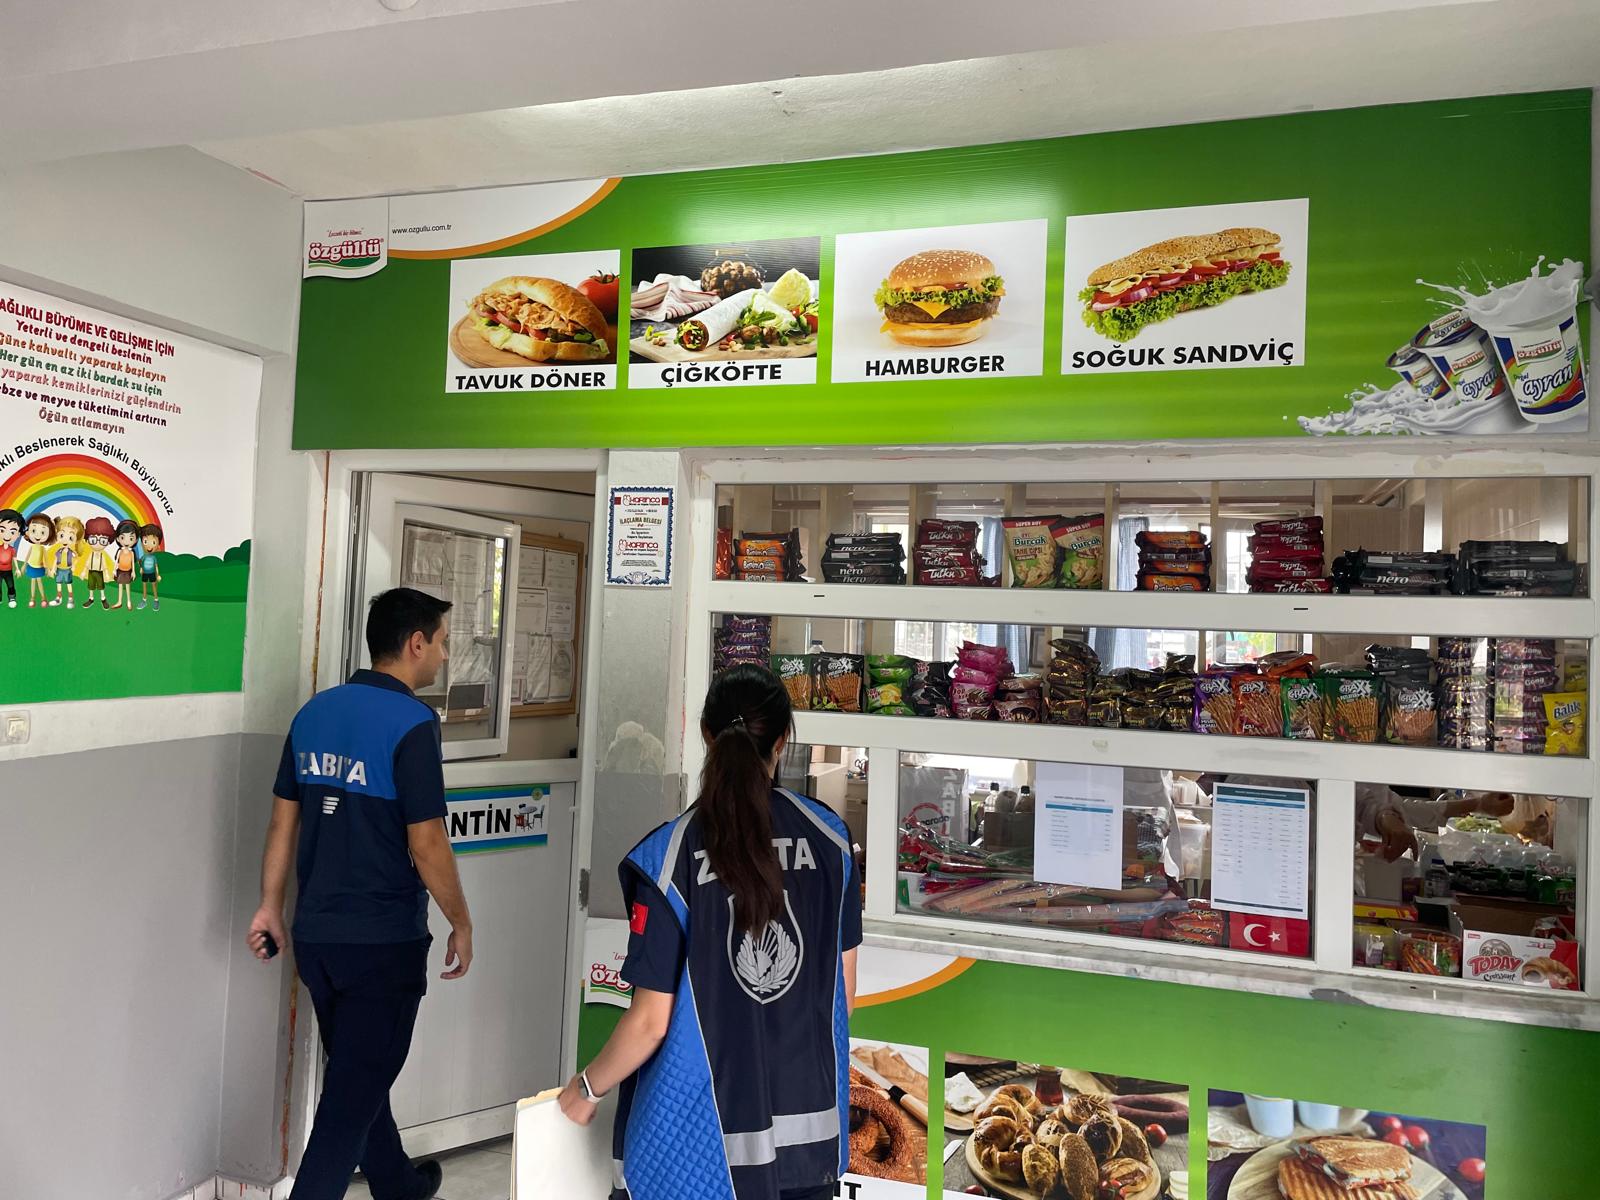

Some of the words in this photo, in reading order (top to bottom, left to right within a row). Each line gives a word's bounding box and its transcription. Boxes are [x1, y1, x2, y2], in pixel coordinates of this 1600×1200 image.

[391, 224, 452, 235] www.ozgullu.com.tr
[309, 238, 381, 263] özgüllü
[16, 320, 53, 339] Yeterli
[55, 332, 68, 342] ve
[70, 334, 109, 353] dengeli
[111, 344, 152, 364] beslenin
[45, 311, 93, 335] BÜYÜME
[94, 324, 108, 338] VE
[109, 329, 153, 351] GELİŞME
[155, 339, 175, 357] İÇİN
[29, 339, 77, 361] kahvaltı
[79, 354, 123, 371] yaparak
[125, 363, 166, 383] başlayın
[865, 355, 1005, 377] HAMBURGER
[1071, 344, 1165, 369] SOĞUK
[1173, 338, 1294, 366] SANDVİÇ
[0, 349, 19, 362] Her
[20, 356, 42, 368] gün
[45, 362, 58, 372] en
[60, 366, 74, 376] az
[77, 367, 91, 379] iki
[93, 371, 129, 388] bardak
[131, 382, 142, 391] su
[144, 383, 162, 396] için
[455, 373, 524, 391] TAVUK
[530, 369, 607, 388] DÖNER
[660, 362, 782, 388] ÇİĞKÖFTE
[1463, 367, 1498, 399] ayran
[1523, 365, 1573, 401] ayran
[1, 368, 49, 386] yaparak
[52, 376, 125, 402] kemiklerinizi
[127, 395, 181, 414] güçlendirin
[0, 383, 22, 397] bze
[25, 391, 38, 400] ve
[40, 393, 76, 408] meyve
[78, 399, 133, 420] tüketimini
[135, 413, 167, 427] artırın
[39, 407, 68, 423] Öğün
[71, 416, 125, 434] atlamayın
[14, 435, 84, 458] Beslenerek
[88, 437, 129, 464] Sağlıklı
[130, 459, 174, 516] Büyüyoruz
[928, 531, 953, 540] Tutku
[922, 556, 949, 566] Tutku
[928, 568, 955, 579] Tutku
[1376, 575, 1409, 584] nero
[1200, 678, 1230, 694] CRAX
[1240, 681, 1267, 693] CRAX
[1287, 683, 1319, 700] CRAX
[1524, 677, 1545, 686] Gong
[693, 838, 817, 885] ZTA
[1467, 955, 1524, 976] TODAY
